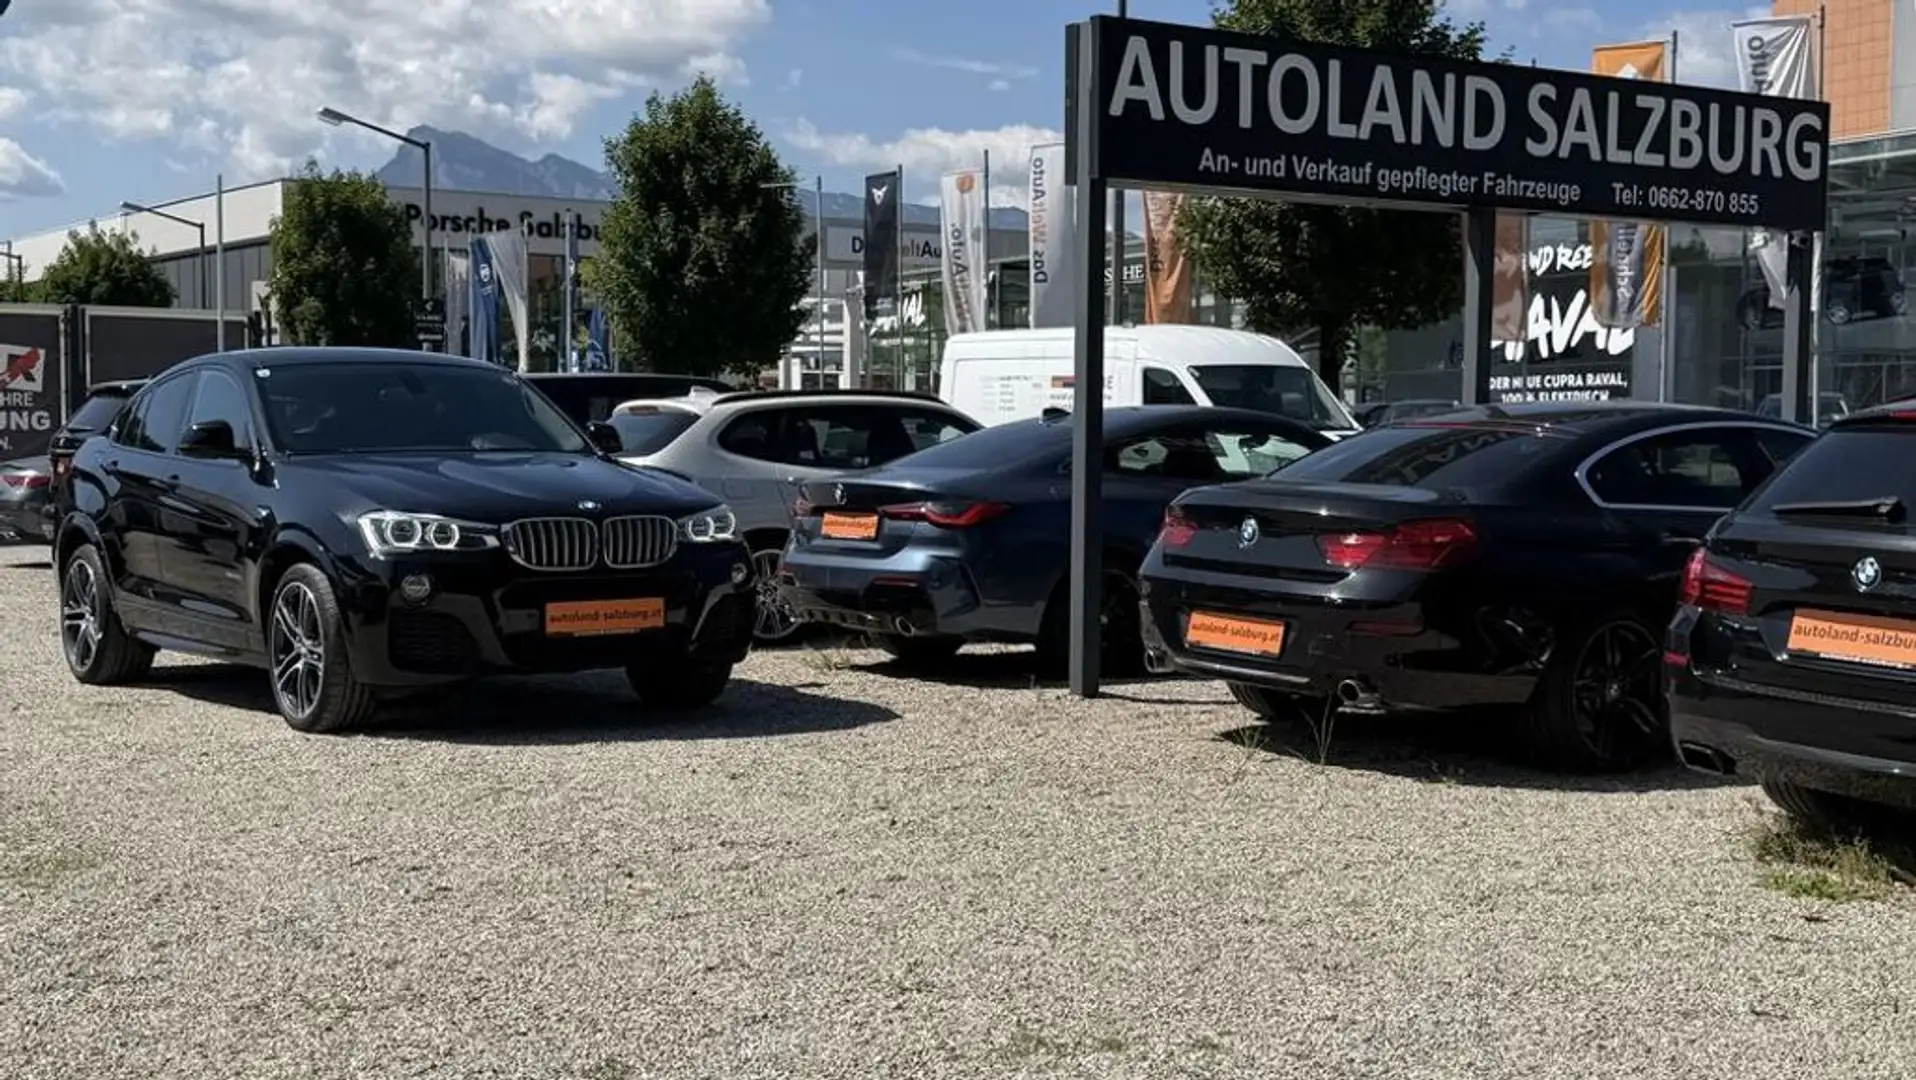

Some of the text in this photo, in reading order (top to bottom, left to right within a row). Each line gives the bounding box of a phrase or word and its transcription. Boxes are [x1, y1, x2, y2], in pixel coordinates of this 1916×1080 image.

[1108, 35, 1823, 181] AUTOLAND SALZBURG
[1198, 147, 1581, 205] An- und Verkauf gepflegter Fahrzeuge
[1611, 182, 1760, 215] Tel: 0662-870 855
[405, 203, 510, 234] Porsche
[1543, 373, 1583, 388] CUPRA
